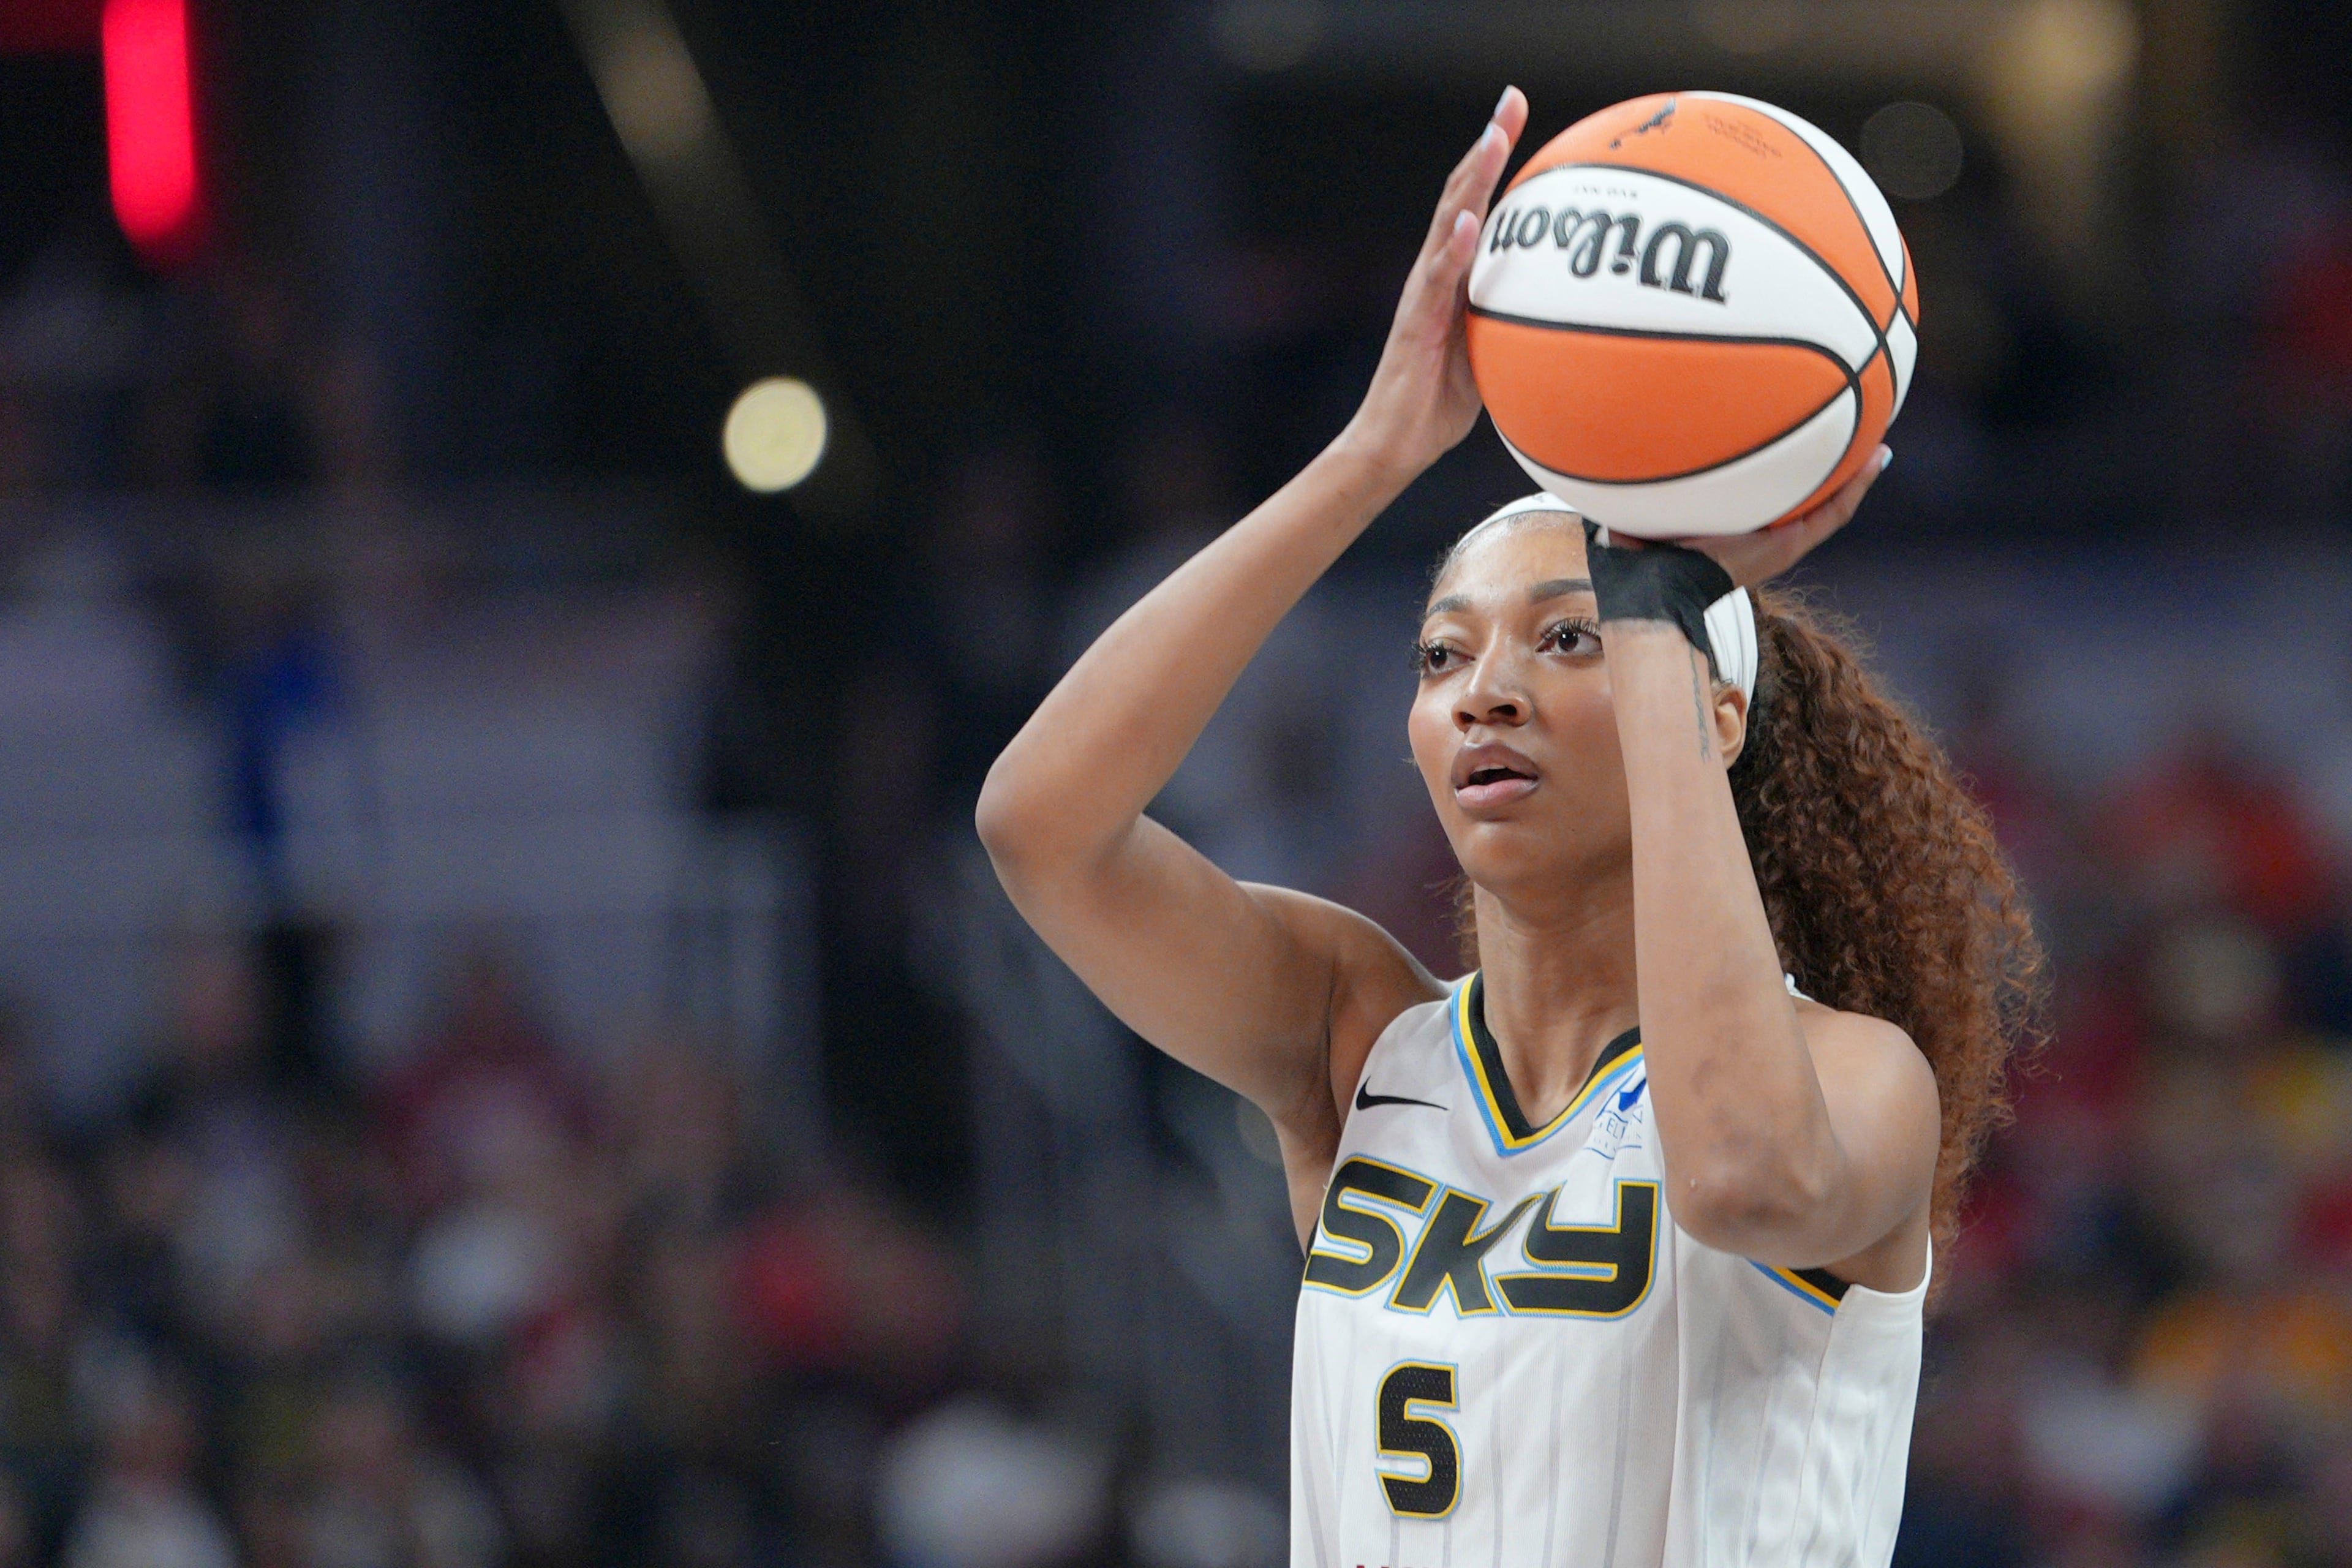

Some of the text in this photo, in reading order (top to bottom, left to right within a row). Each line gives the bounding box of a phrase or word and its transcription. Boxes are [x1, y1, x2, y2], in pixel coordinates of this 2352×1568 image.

[1488, 205, 1730, 304] Wilson
[1302, 1153, 1662, 1321] SKY
[1375, 1359, 1463, 1520] 5
